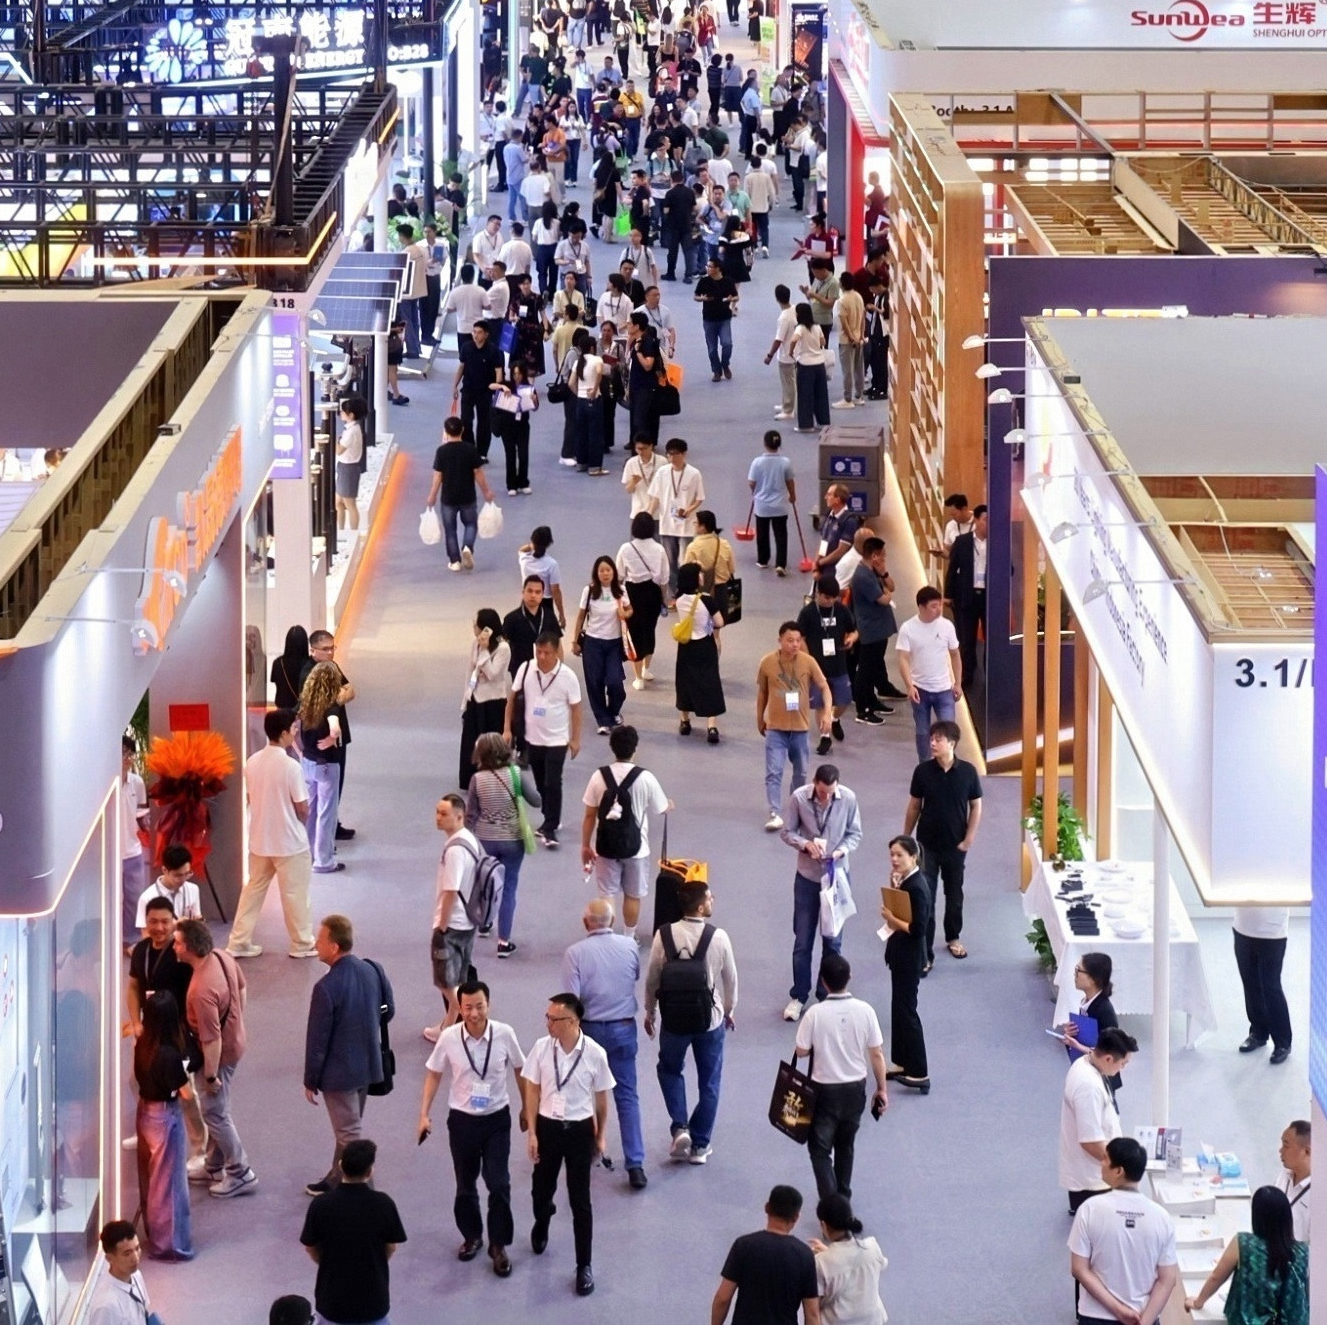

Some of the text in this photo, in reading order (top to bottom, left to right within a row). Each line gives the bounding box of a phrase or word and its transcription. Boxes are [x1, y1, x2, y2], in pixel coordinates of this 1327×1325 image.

[1253, 29, 1306, 38] SHENGHUI
[387, 43, 429, 61] O:B28
[1235, 658, 1314, 690] 3.1/
